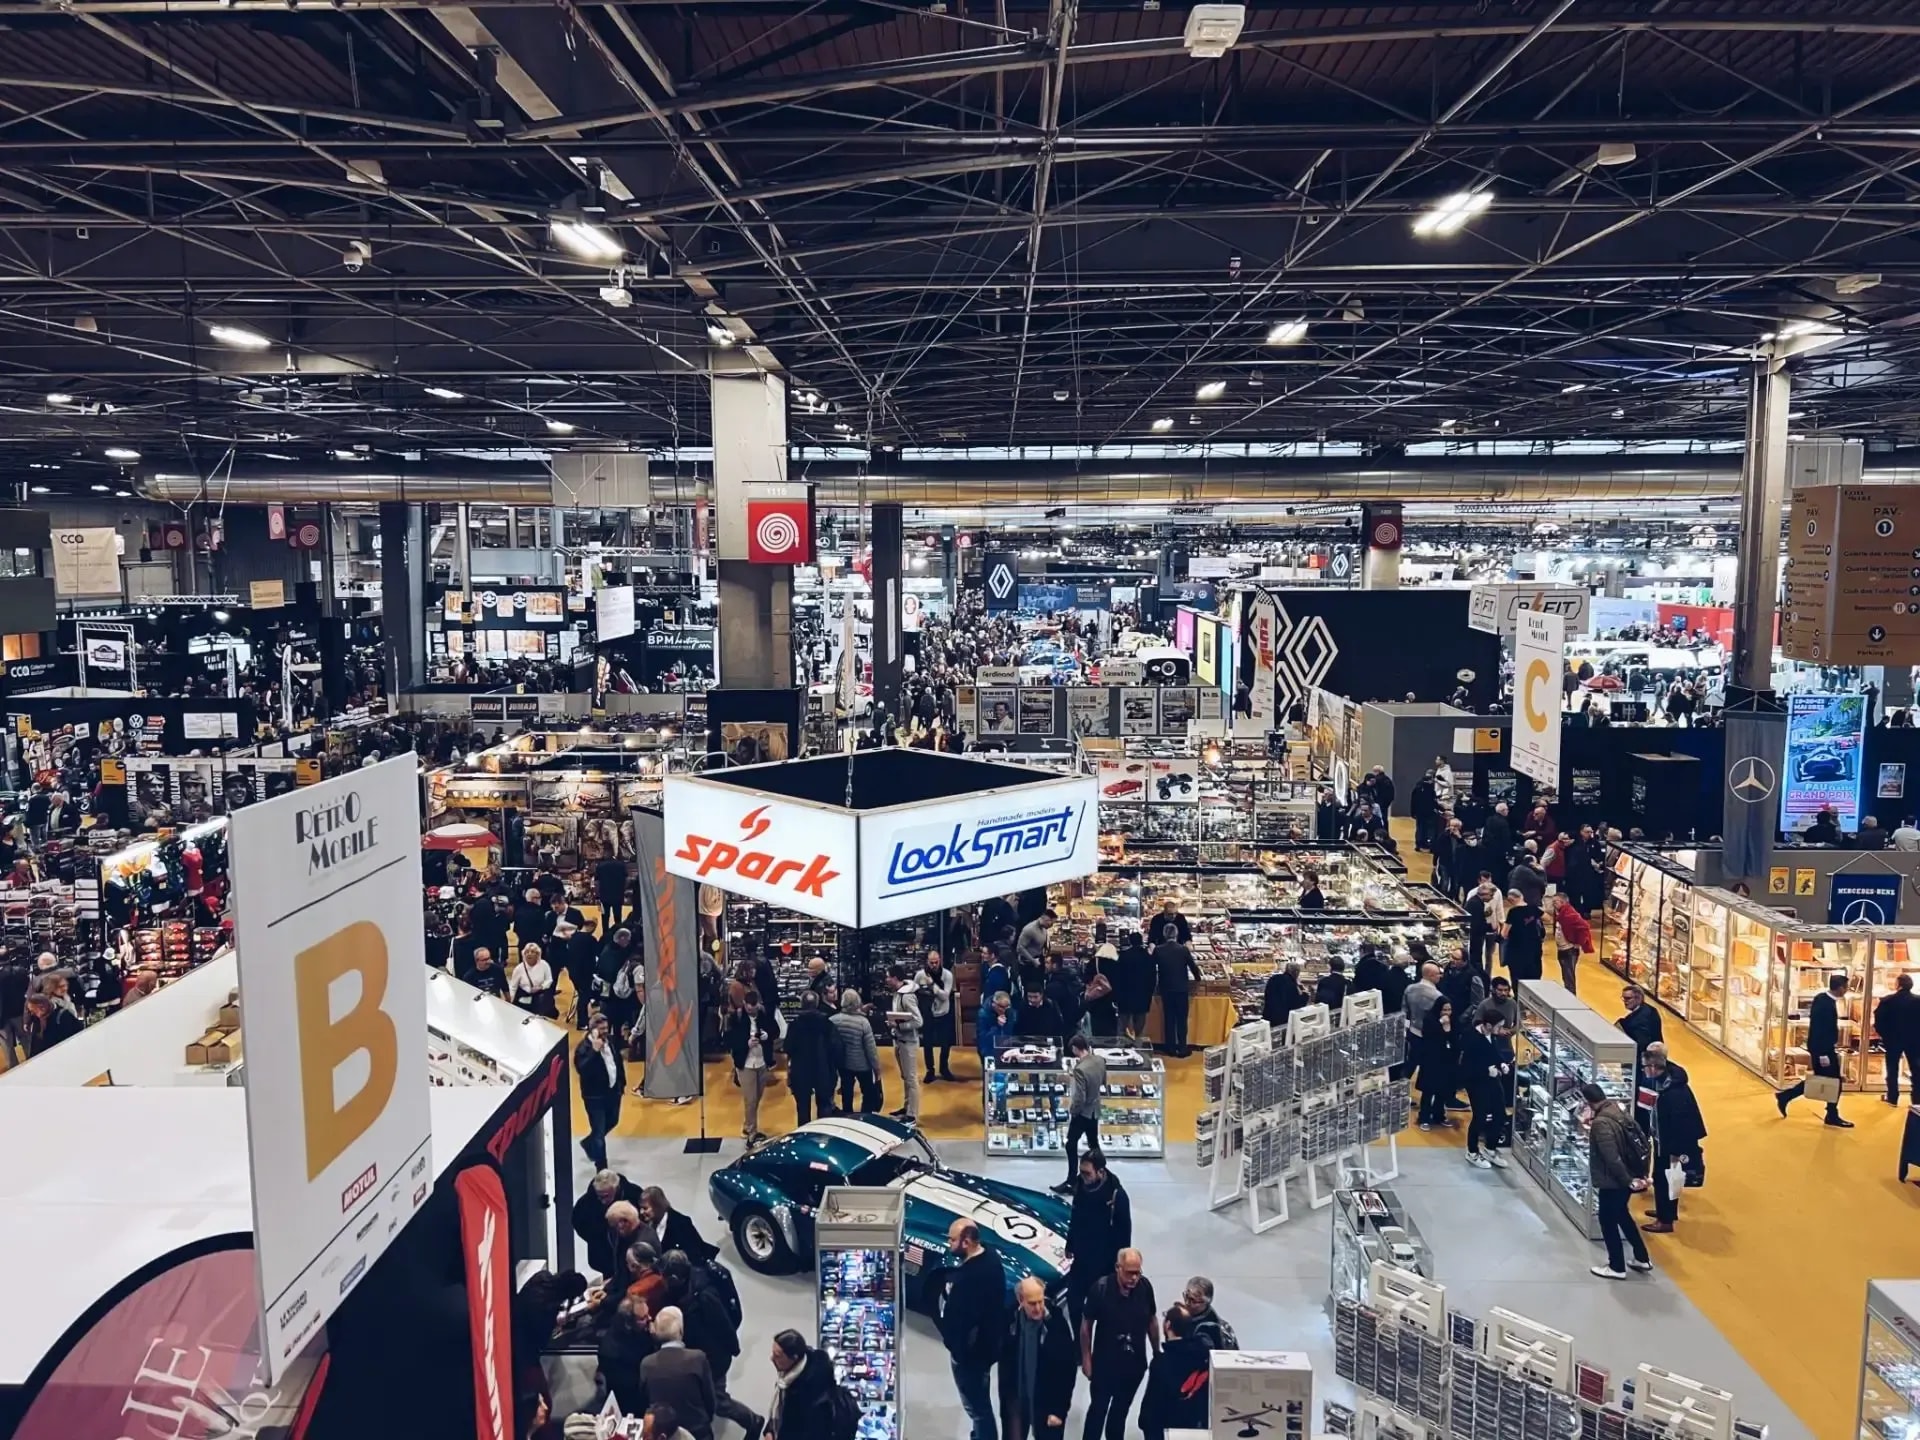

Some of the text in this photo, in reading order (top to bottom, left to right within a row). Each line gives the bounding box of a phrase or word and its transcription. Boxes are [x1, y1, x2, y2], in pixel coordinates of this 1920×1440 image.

[1881, 523, 1888, 533] 1
[648, 635, 674, 645] BPM
[1524, 658, 1550, 733] C
[127, 771, 138, 803] WAGNER
[256, 772, 265, 801] TAMBAY
[1790, 791, 1854, 799] GRAND PRIX
[1805, 783, 1828, 791] PAU
[976, 806, 1056, 826] Handmade models
[674, 834, 840, 897] spark
[1837, 888, 1896, 896] MERCEDES-BENZ
[294, 920, 399, 1184] B
[343, 1165, 376, 1212] MOTUL
[1004, 1216, 1037, 1240] 5
[908, 1235, 946, 1254] AMERICAN
